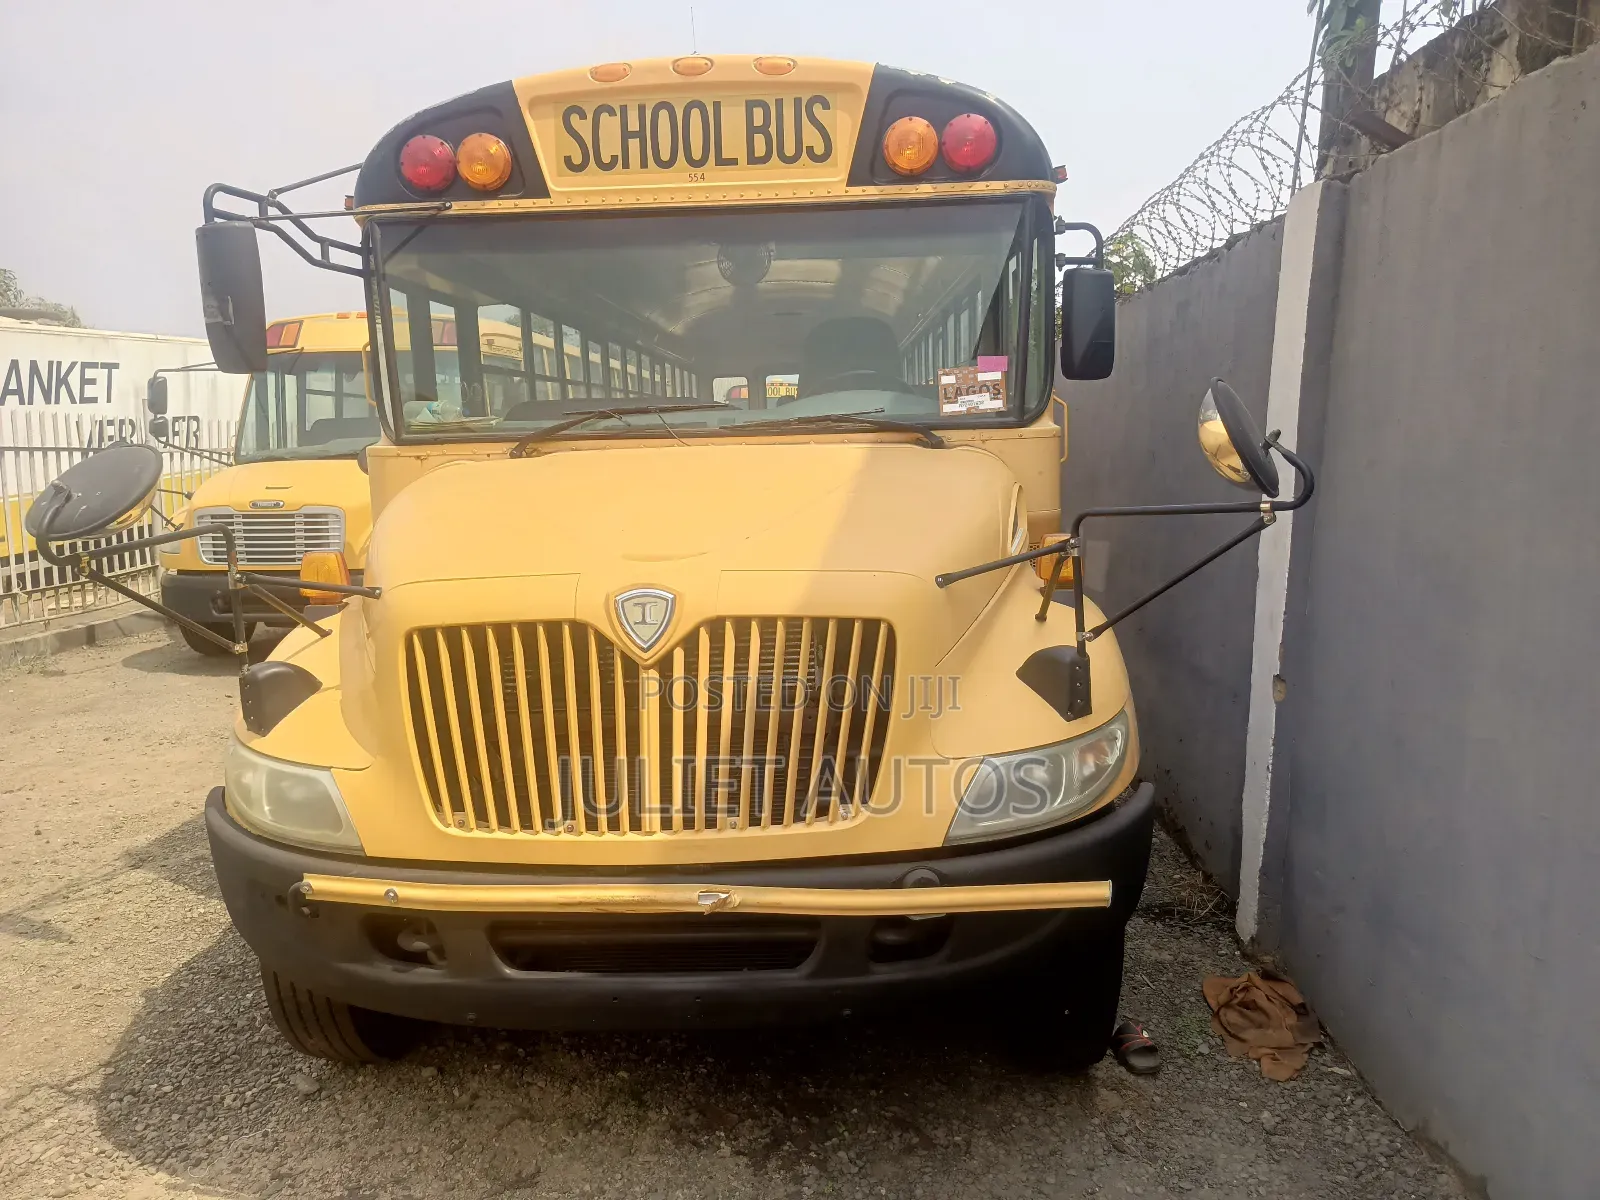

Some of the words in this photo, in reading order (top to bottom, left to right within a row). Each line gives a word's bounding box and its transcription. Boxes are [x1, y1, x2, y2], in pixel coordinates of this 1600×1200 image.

[562, 100, 738, 173] SCHOOL
[745, 95, 833, 165] BUS
[688, 172, 706, 183] 554
[0, 359, 119, 405] ANKET
[943, 384, 1001, 401] LAGOS
